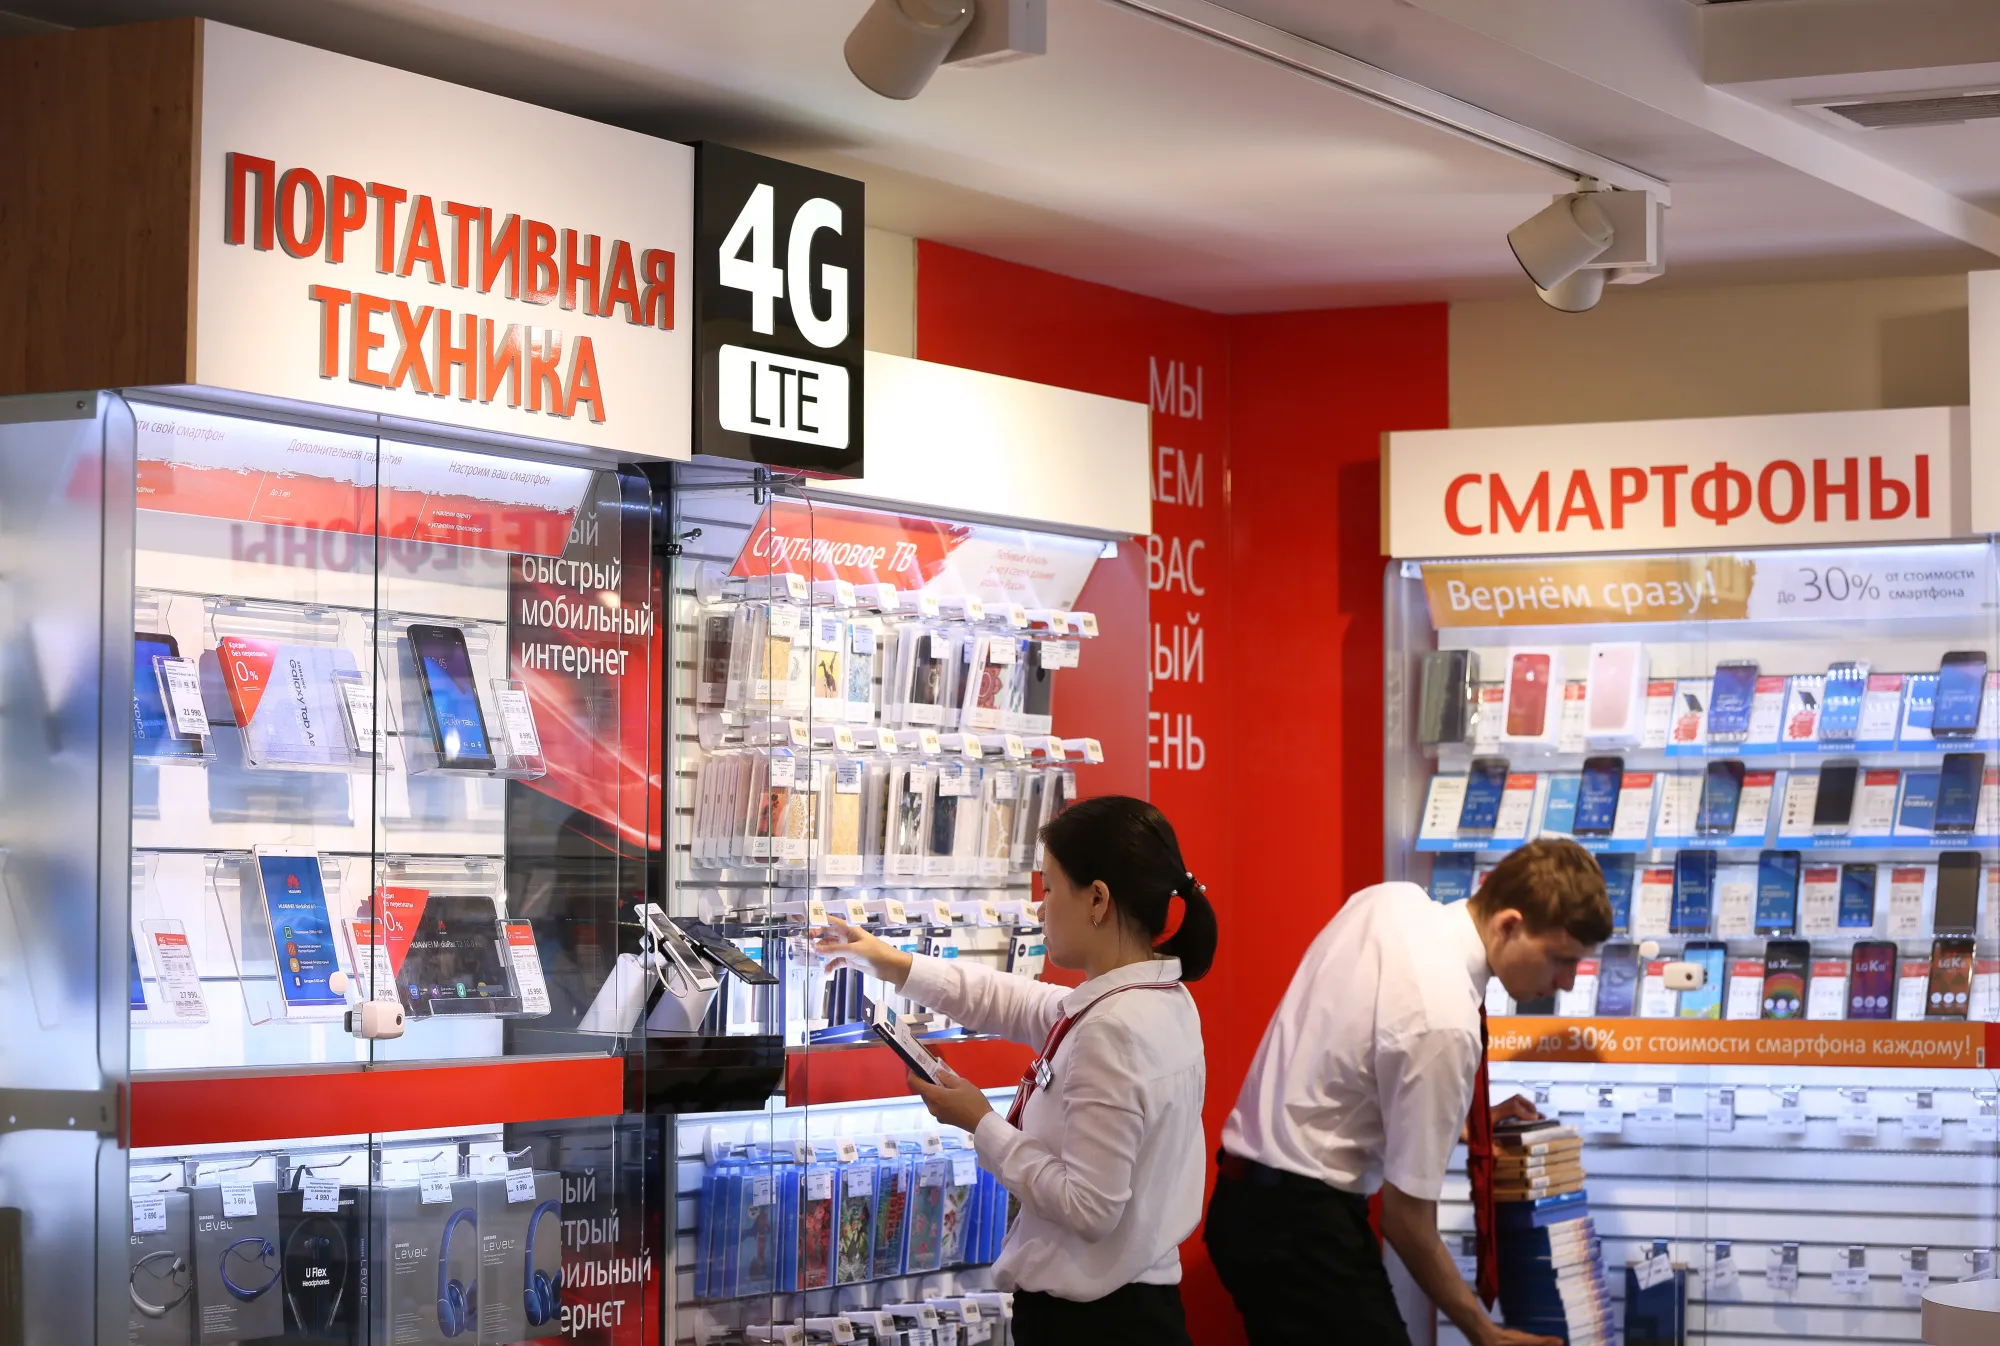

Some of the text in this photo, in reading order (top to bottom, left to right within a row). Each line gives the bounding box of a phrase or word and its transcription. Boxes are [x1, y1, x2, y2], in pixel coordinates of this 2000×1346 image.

[226, 152, 676, 331] ПОРТАТИВНАЯ
[719, 182, 849, 349] 4G
[309, 284, 607, 424] ТЕХНИКА
[750, 361, 820, 434] LTE
[1149, 356, 1204, 420] МЫ
[151, 420, 176, 435] свой
[176, 425, 225, 442] смартфон
[287, 438, 362, 461] Дополнительная
[449, 460, 551, 487] Настроим ваш смартфон
[1444, 454, 1931, 536] СМАРТФОНЫ
[569, 512, 599, 547] ый
[753, 527, 918, 573] Спутниковое ТВ
[1148, 534, 1206, 597] ВАС
[1777, 565, 1975, 604] До 30% от стоимости
[522, 594, 654, 637] мобильный
[1446, 569, 1719, 619] Вернём сразу!
[1888, 586, 1966, 602] смартфона
[521, 642, 629, 680] интернет
[1148, 612, 1205, 693] ЫЙ
[289, 658, 306, 706] Galaxy
[300, 705, 311, 729] Tab
[1148, 711, 1206, 770] ЕНЬ
[1536, 1036, 1562, 1053] до
[1566, 1025, 1618, 1052] 30%
[1622, 1034, 1642, 1052] от
[1648, 1035, 1750, 1054] стоимости
[1755, 1032, 1867, 1057] смартфона
[1872, 1034, 1971, 1060] каждому!
[561, 1167, 596, 1204] ый
[302, 1278, 330, 1288] Headphones
[305, 1266, 327, 1278] U Flex
[561, 1300, 625, 1338] ернет
